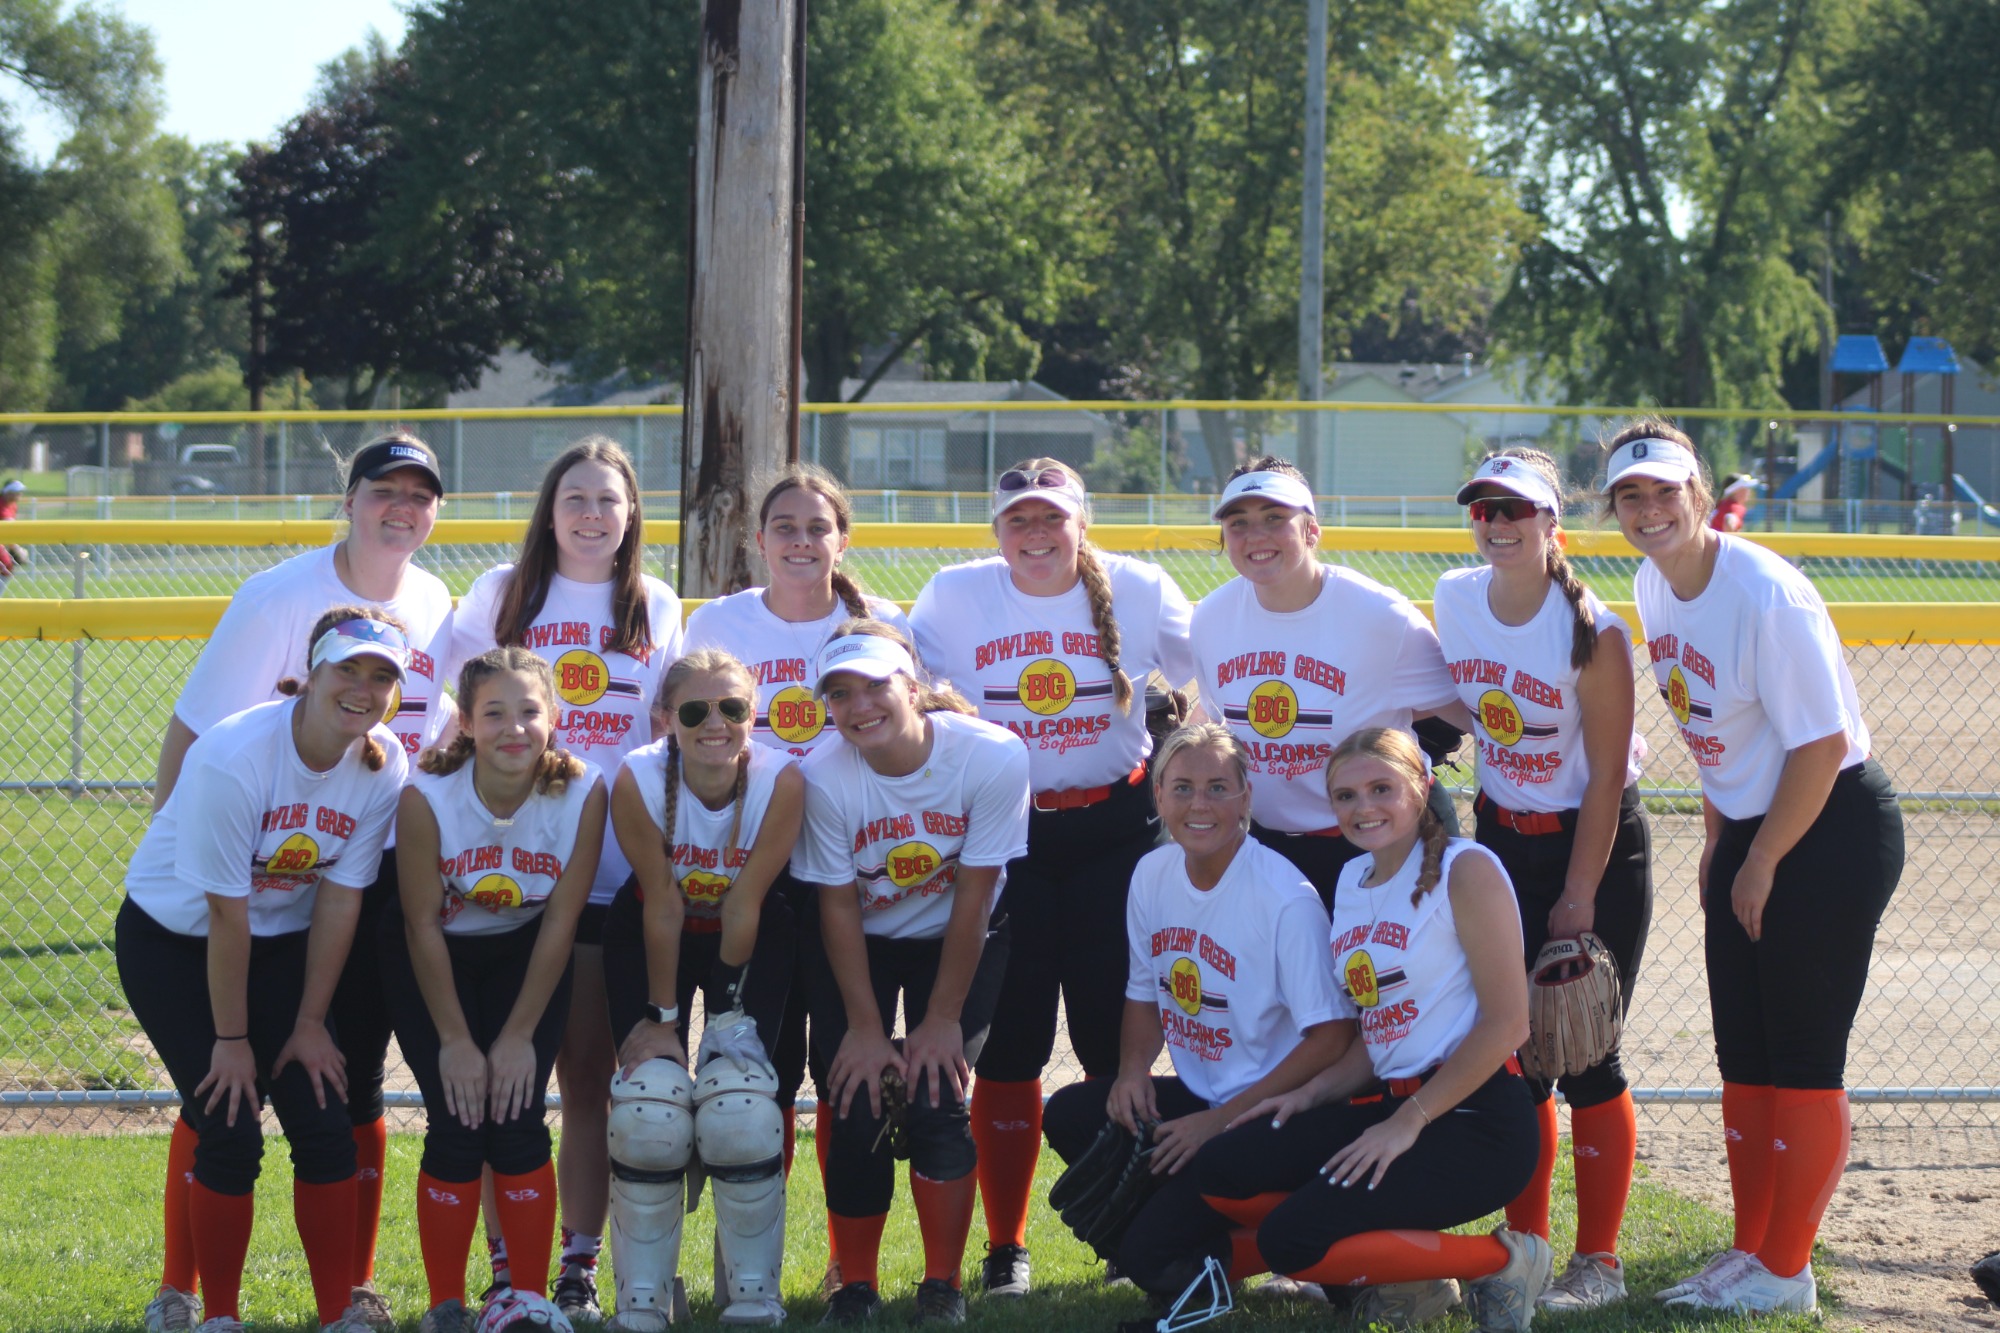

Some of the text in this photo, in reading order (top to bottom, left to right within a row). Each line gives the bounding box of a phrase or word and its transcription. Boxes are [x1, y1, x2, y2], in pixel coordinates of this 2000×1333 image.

[390, 446, 428, 464] FINESSE
[521, 622, 590, 650] OWLING
[409, 648, 434, 682] EEN
[976, 631, 1105, 671] BOWLING GREE
[562, 663, 599, 690] BG
[1218, 651, 1346, 696] BOWLING GREEN
[1682, 642, 1716, 690] GREEN
[1027, 673, 1066, 701] BG
[1512, 670, 1564, 709] GREEN
[1671, 679, 1686, 711] BG
[555, 710, 634, 733] LCONS
[777, 700, 817, 728] BG
[1254, 695, 1289, 723] BG
[1484, 702, 1517, 733] BG
[566, 727, 625, 751] Softball
[1039, 730, 1102, 755] Softball
[1243, 741, 1333, 763] ALCONS
[1268, 757, 1324, 781] Softball
[1501, 764, 1554, 787] Softball
[272, 849, 312, 870] BG
[512, 847, 562, 880] GREEN
[893, 855, 933, 879] BG
[687, 878, 725, 897] BG
[1371, 921, 1411, 950] GREEN
[1199, 934, 1236, 981] GREEN
[1541, 943, 1573, 957] Wilson
[1175, 971, 1198, 1003] BG
[1348, 964, 1374, 996] BG
[1162, 1008, 1233, 1049] FALCONS
[1373, 1021, 1412, 1050] Softball
